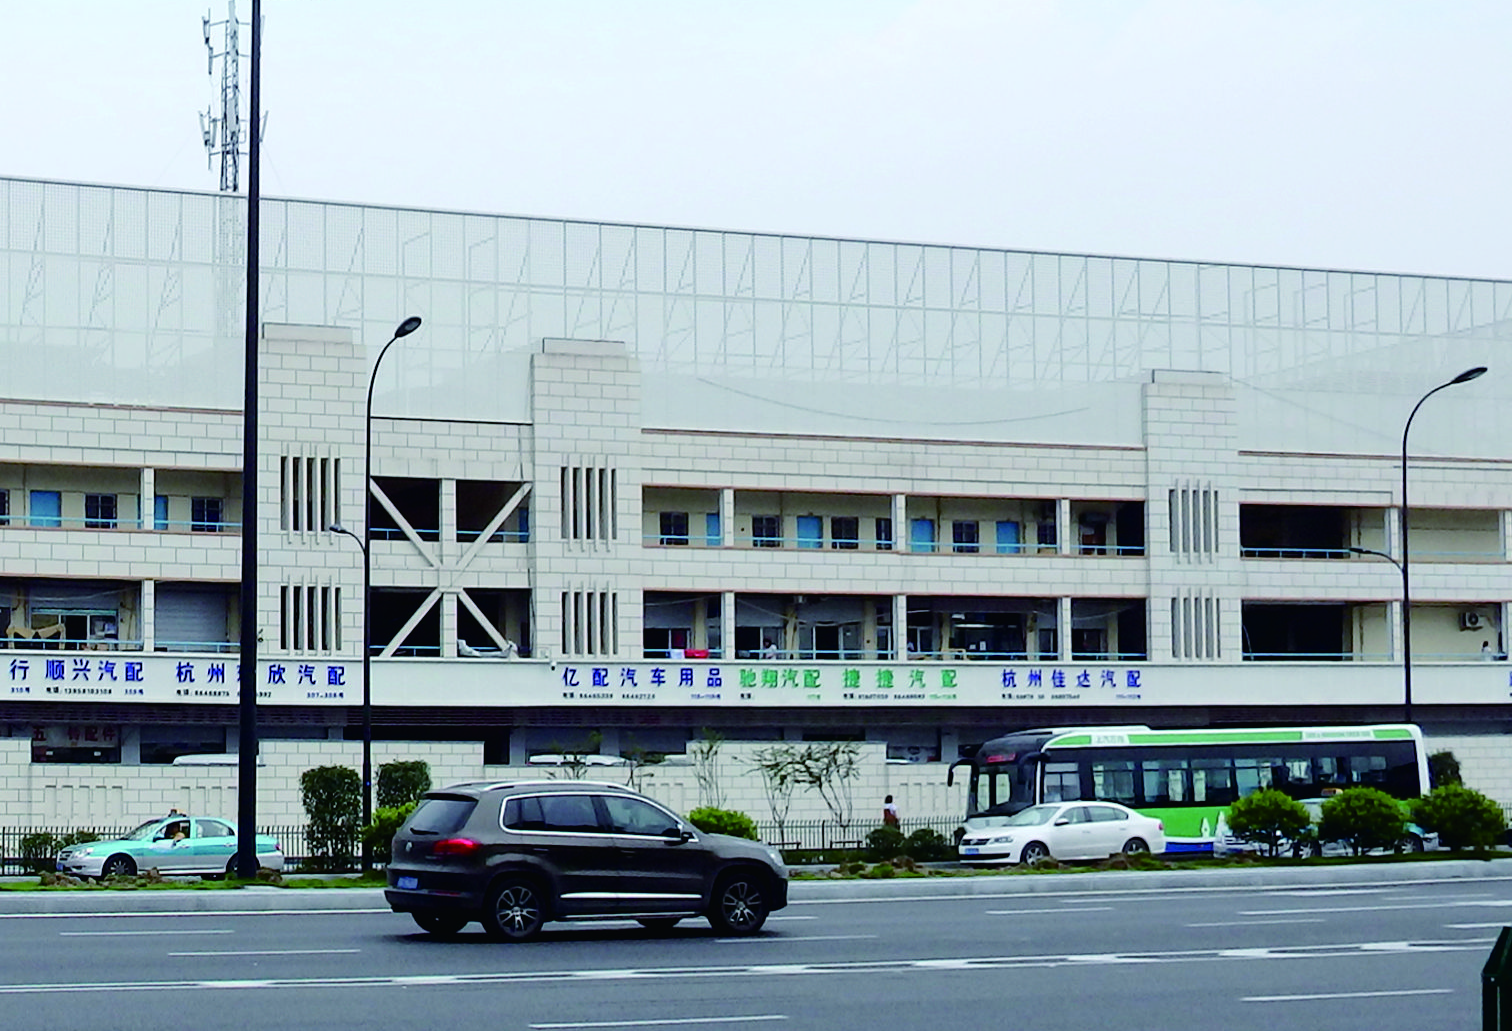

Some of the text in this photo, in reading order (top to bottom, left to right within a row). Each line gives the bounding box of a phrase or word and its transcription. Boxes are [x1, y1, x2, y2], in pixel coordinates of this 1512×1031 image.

[44, 658, 144, 682] 顺兴汽配
[176, 661, 346, 686] 杭州欣汽配
[562, 667, 722, 688] 亿配汽车用品
[1002, 669, 1141, 688] 杭州佳达汽配
